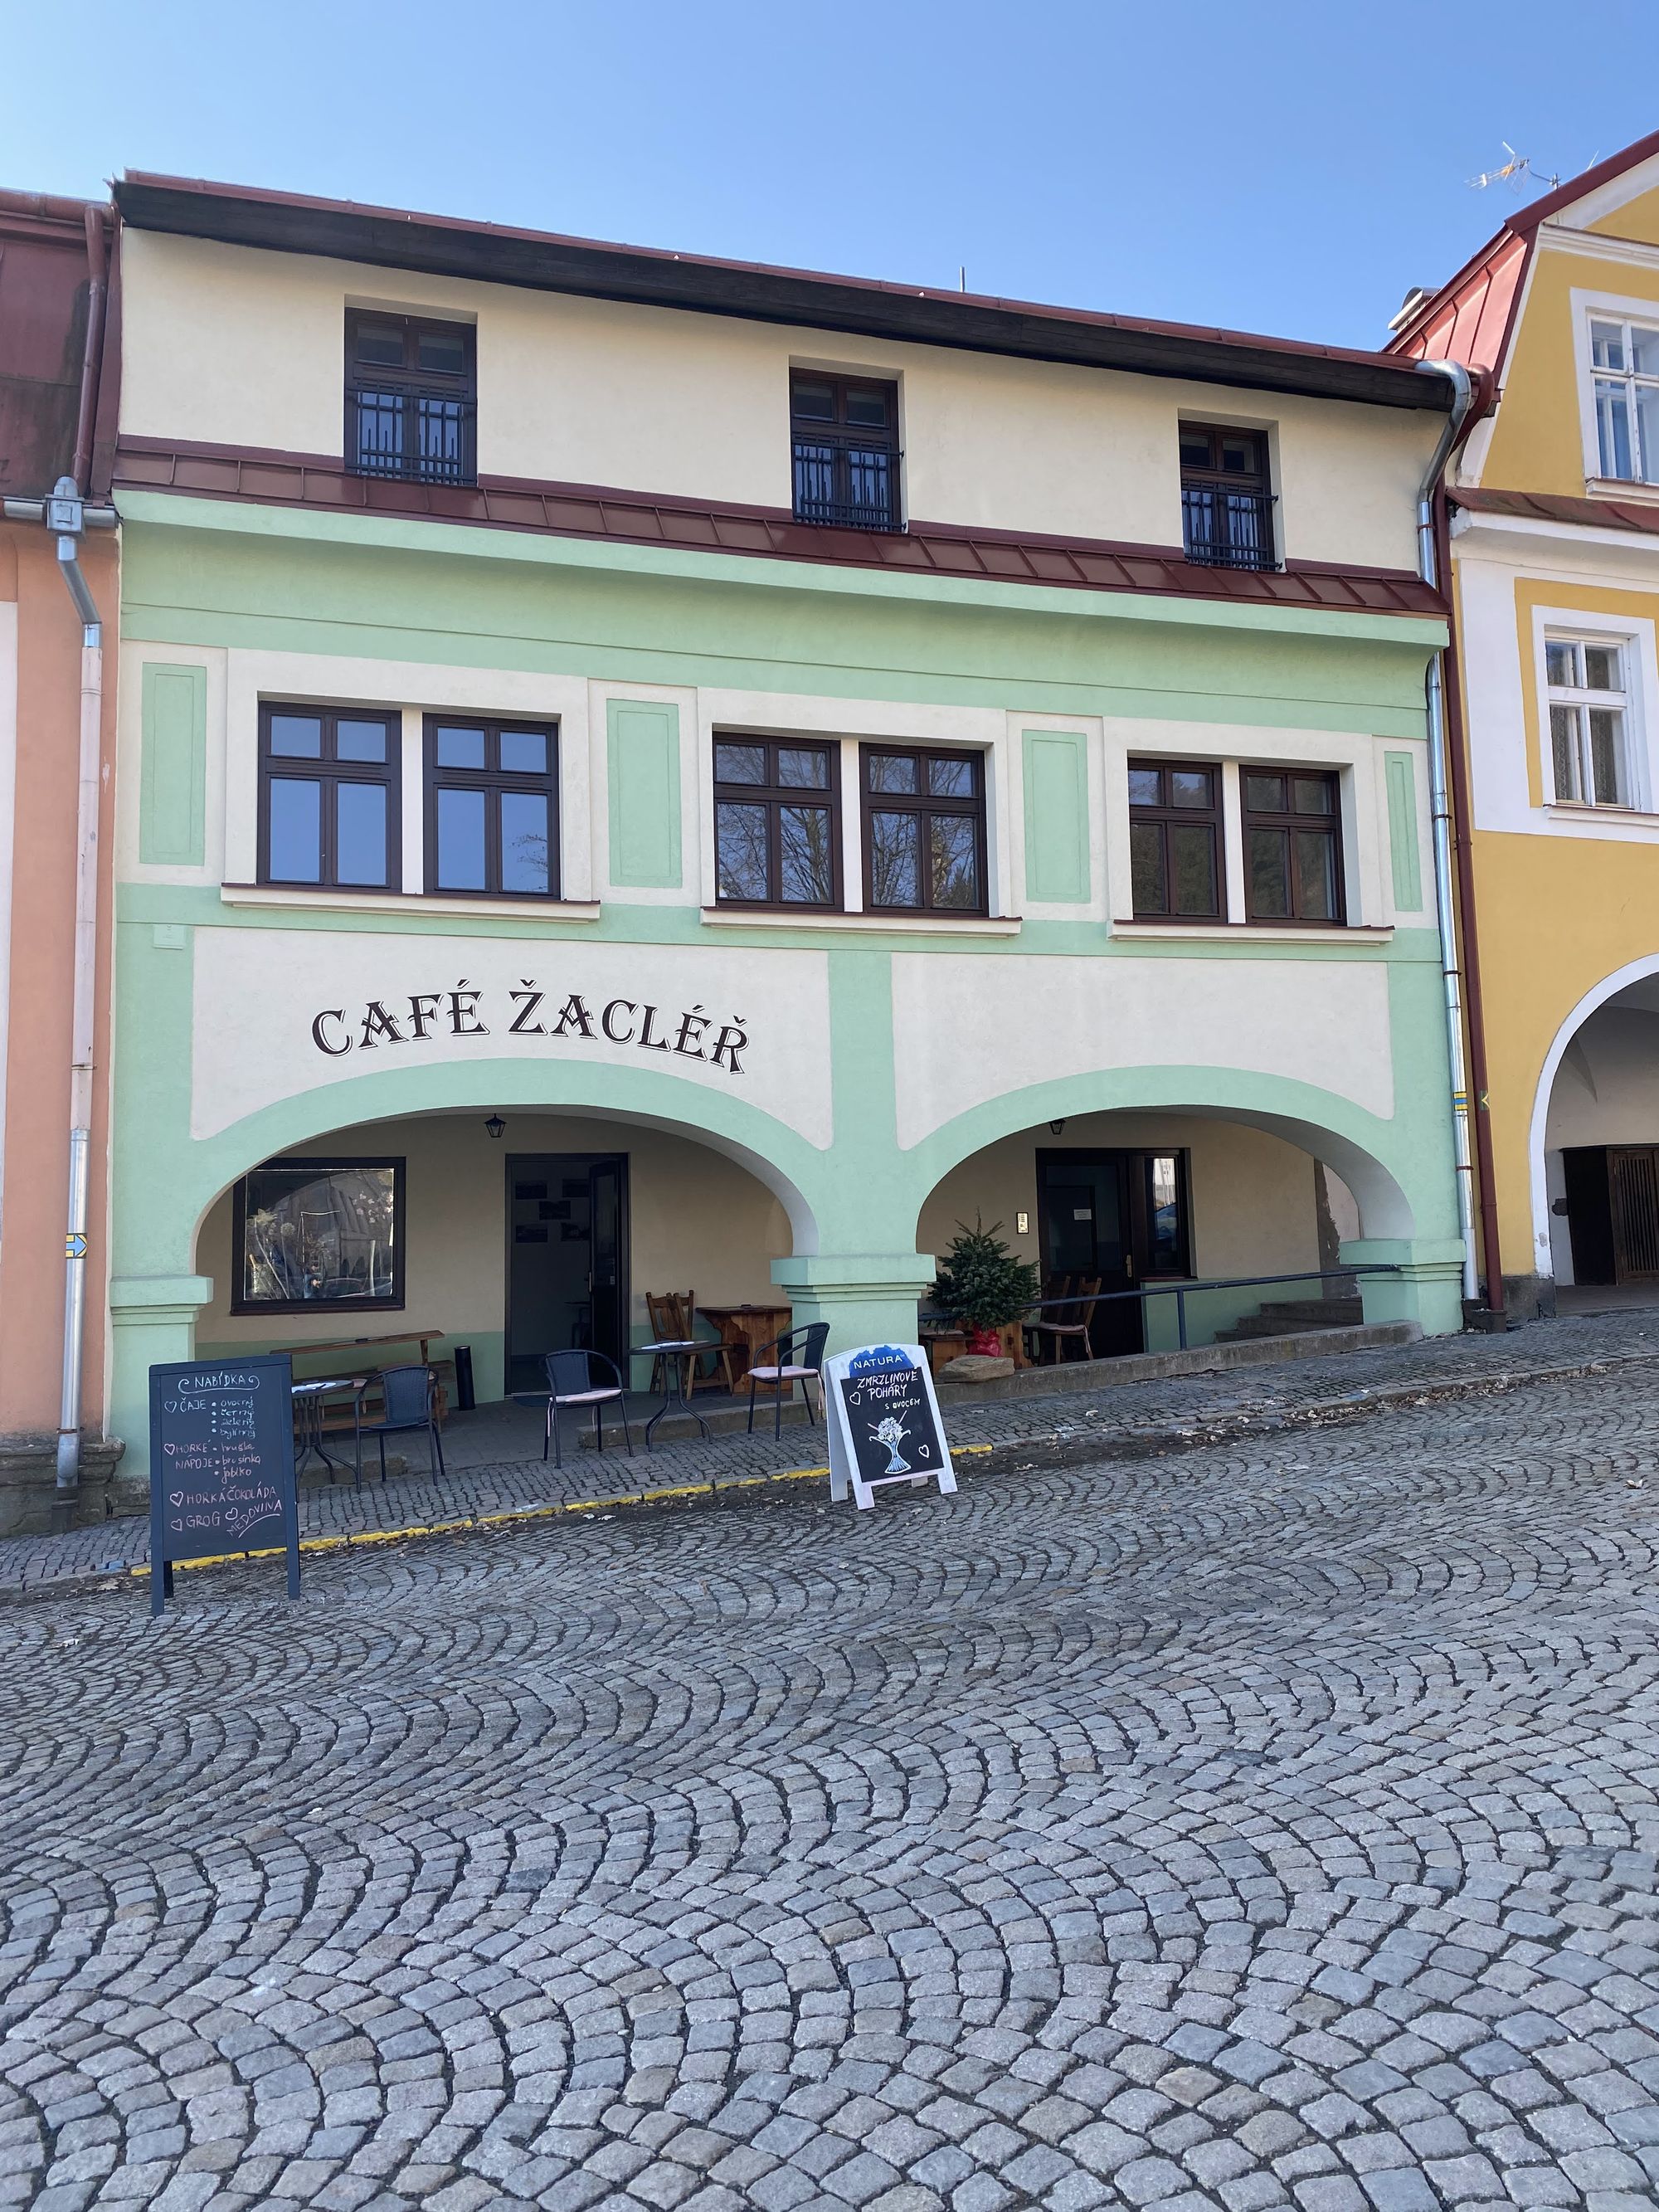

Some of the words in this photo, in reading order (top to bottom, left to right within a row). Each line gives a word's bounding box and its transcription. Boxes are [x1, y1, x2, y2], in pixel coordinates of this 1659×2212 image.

[311, 979, 489, 1057] CAFÉ
[508, 979, 750, 1074] ŽACLÉŘ
[854, 1355, 902, 1369] NATURA
[194, 1371, 246, 1387] NABÍDKA
[867, 1383, 907, 1401] POHÁRY
[180, 1396, 207, 1412] ČAJE
[893, 1398, 921, 1410] OVOCEM
[175, 1454, 213, 1469] NÁPOJE
[187, 1488, 226, 1505] HORKÁ
[227, 1481, 277, 1501] ČOKOLÁDA
[186, 1511, 220, 1528] GROG
[226, 1499, 282, 1536] MEDOVINA
